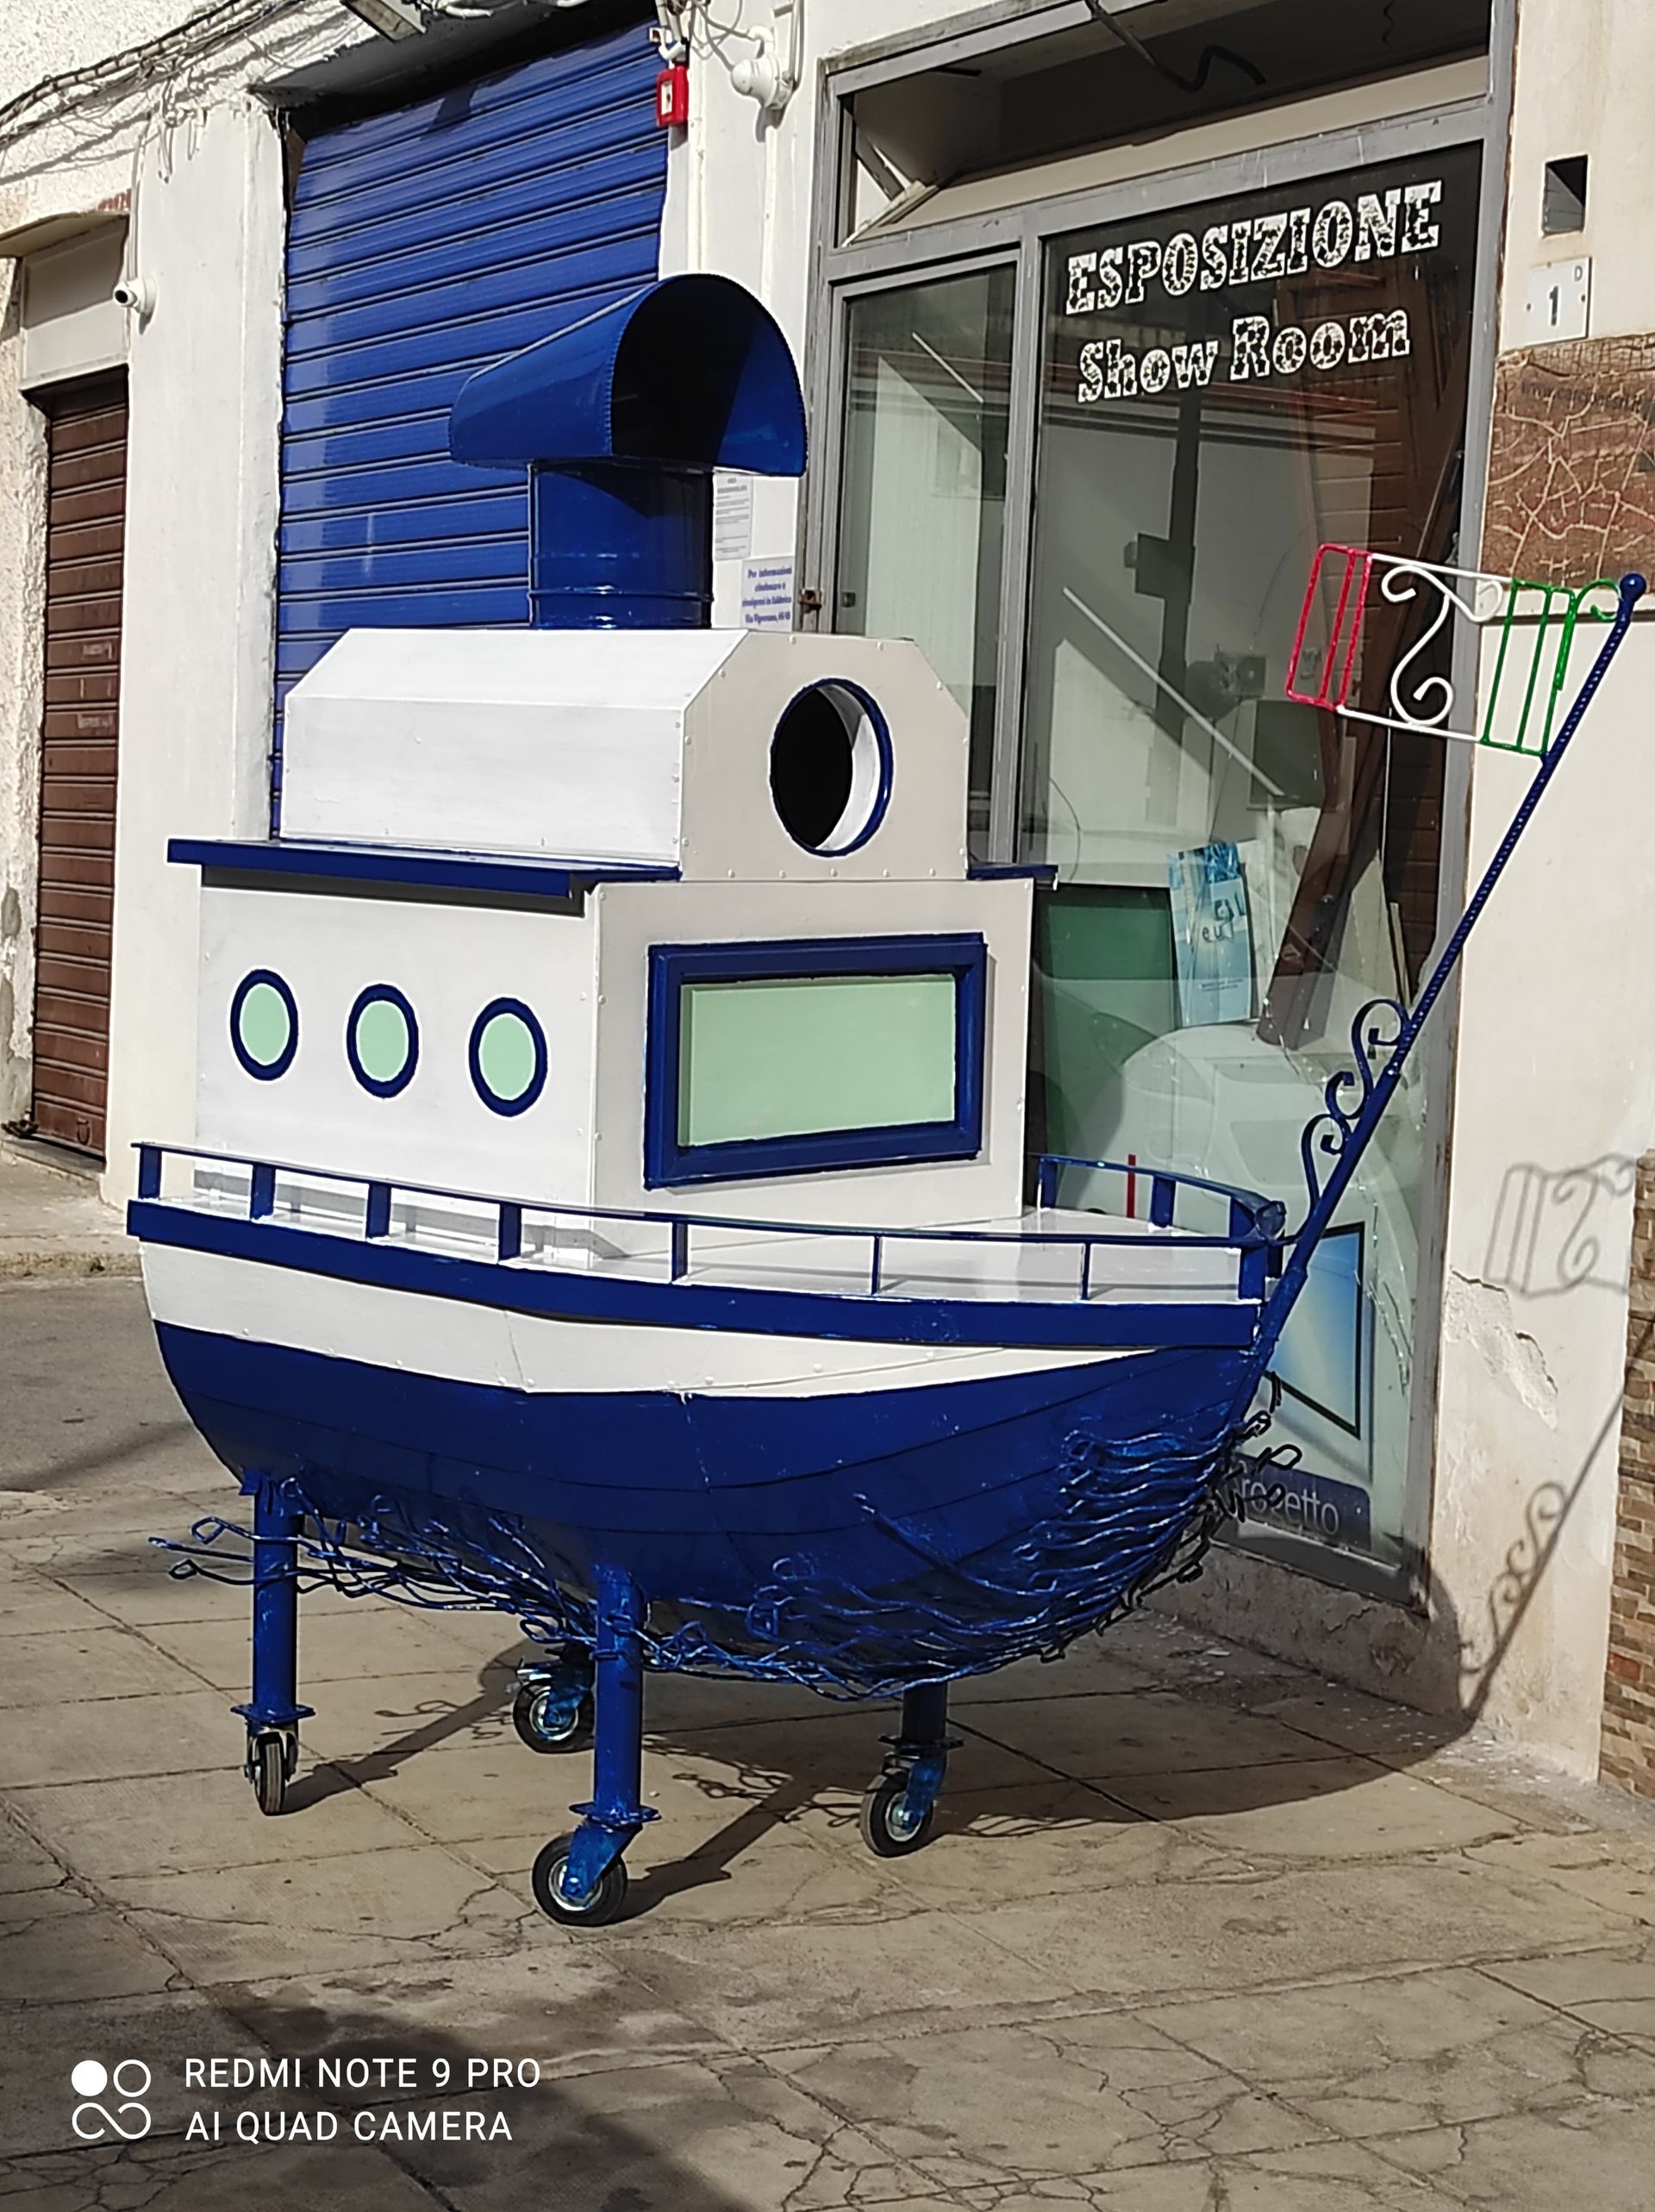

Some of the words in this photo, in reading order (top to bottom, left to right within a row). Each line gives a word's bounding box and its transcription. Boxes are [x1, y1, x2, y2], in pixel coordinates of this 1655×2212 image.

[1065, 179, 1443, 316] ESPOSIZIONE
[1549, 285, 1559, 326] 1
[1077, 339, 1219, 403] Show
[1230, 309, 1411, 381] Room
[1224, 1472, 1340, 1536] roetto
